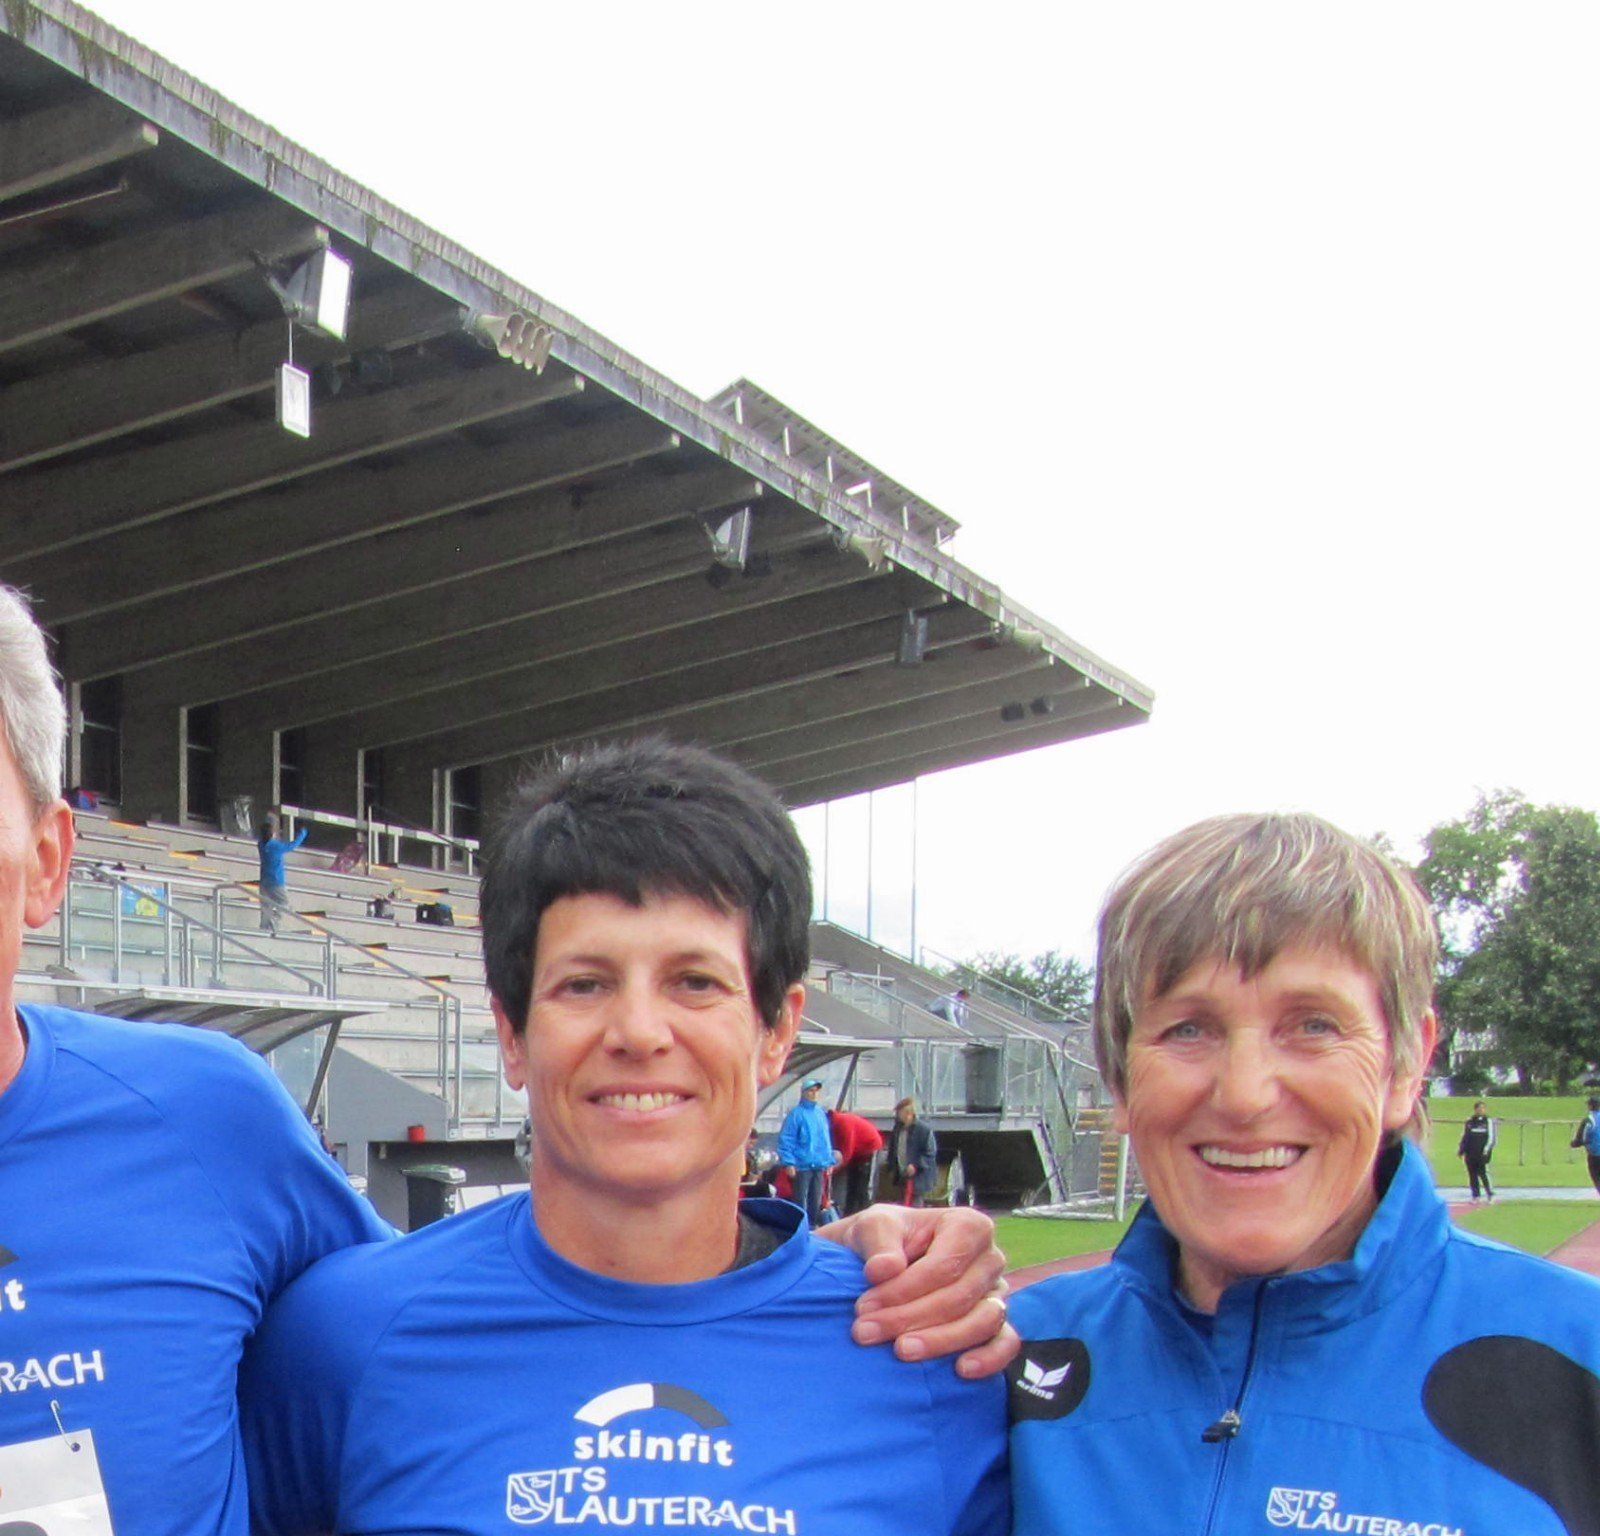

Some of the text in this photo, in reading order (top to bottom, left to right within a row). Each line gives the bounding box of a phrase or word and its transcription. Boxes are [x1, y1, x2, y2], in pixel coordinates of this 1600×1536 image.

[573, 1429, 733, 1467] skinfit
[558, 1466, 607, 1494] TS
[554, 1495, 796, 1536] LAUTERACH
[1304, 1490, 1337, 1511] TS
